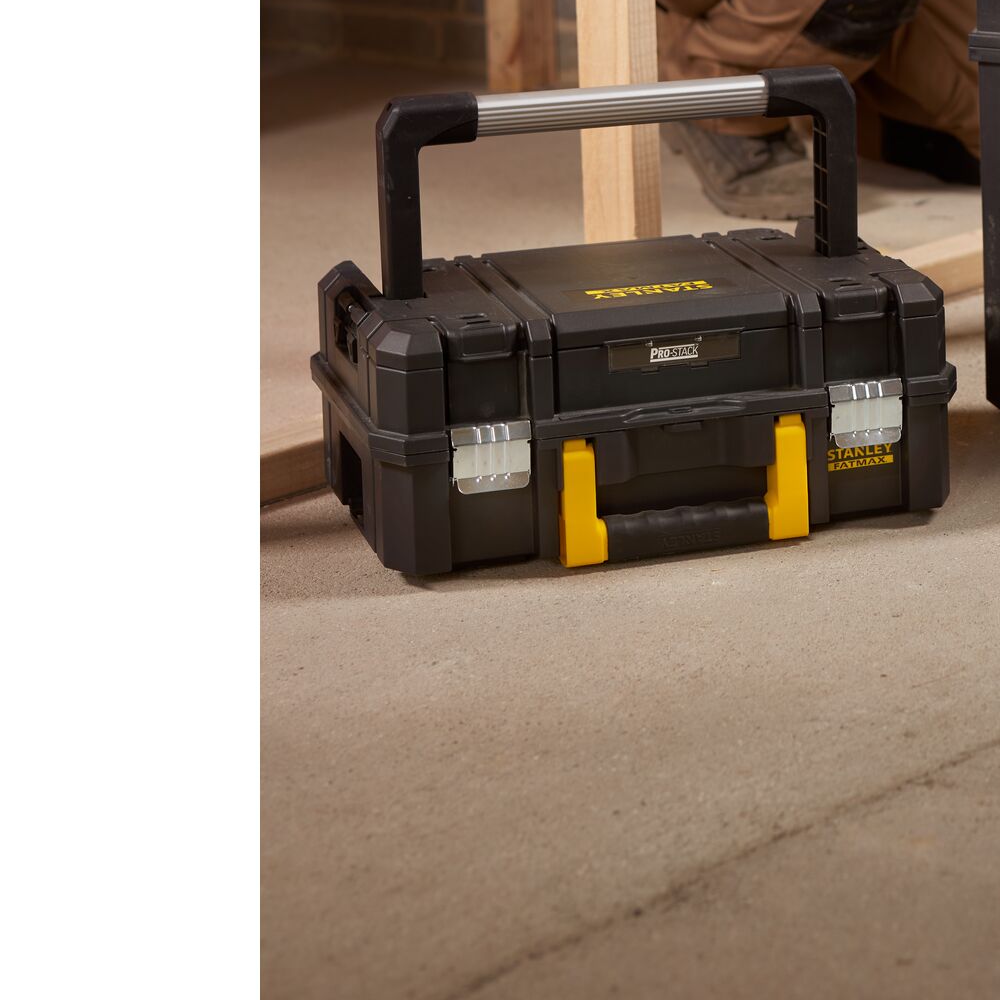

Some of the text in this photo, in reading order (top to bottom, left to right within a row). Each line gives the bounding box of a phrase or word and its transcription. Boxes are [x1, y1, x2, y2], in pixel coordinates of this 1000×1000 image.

[649, 344, 699, 360] PRO-STACK
[827, 443, 893, 462] STANLEY
[834, 456, 886, 470] FATMAX
